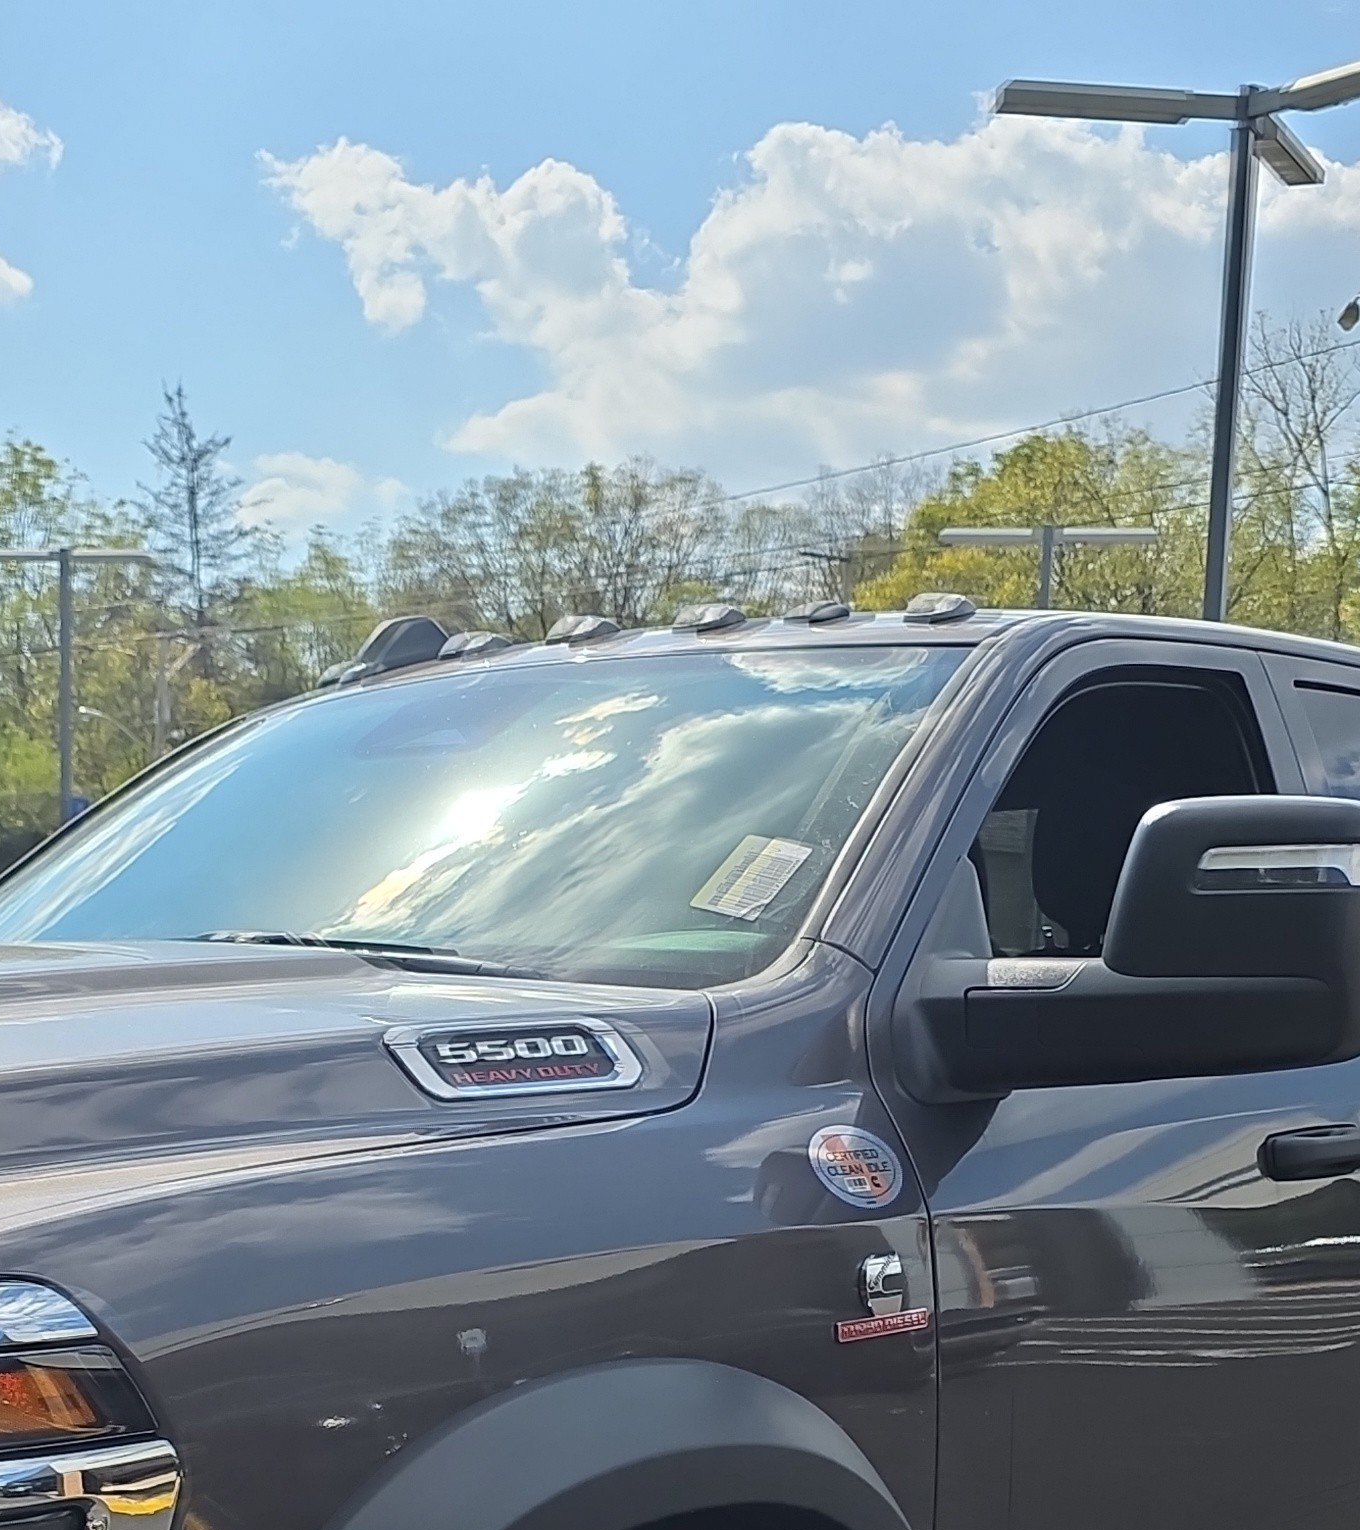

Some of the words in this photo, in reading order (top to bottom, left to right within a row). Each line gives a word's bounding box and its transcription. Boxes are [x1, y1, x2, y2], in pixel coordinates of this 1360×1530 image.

[435, 1034, 589, 1064] 5500
[452, 1067, 533, 1085] HEAVY
[536, 1062, 600, 1079] DUTY
[825, 1148, 879, 1162] CERTIFIED
[827, 1162, 865, 1177] CLEAN
[866, 1161, 892, 1173] IDLE
